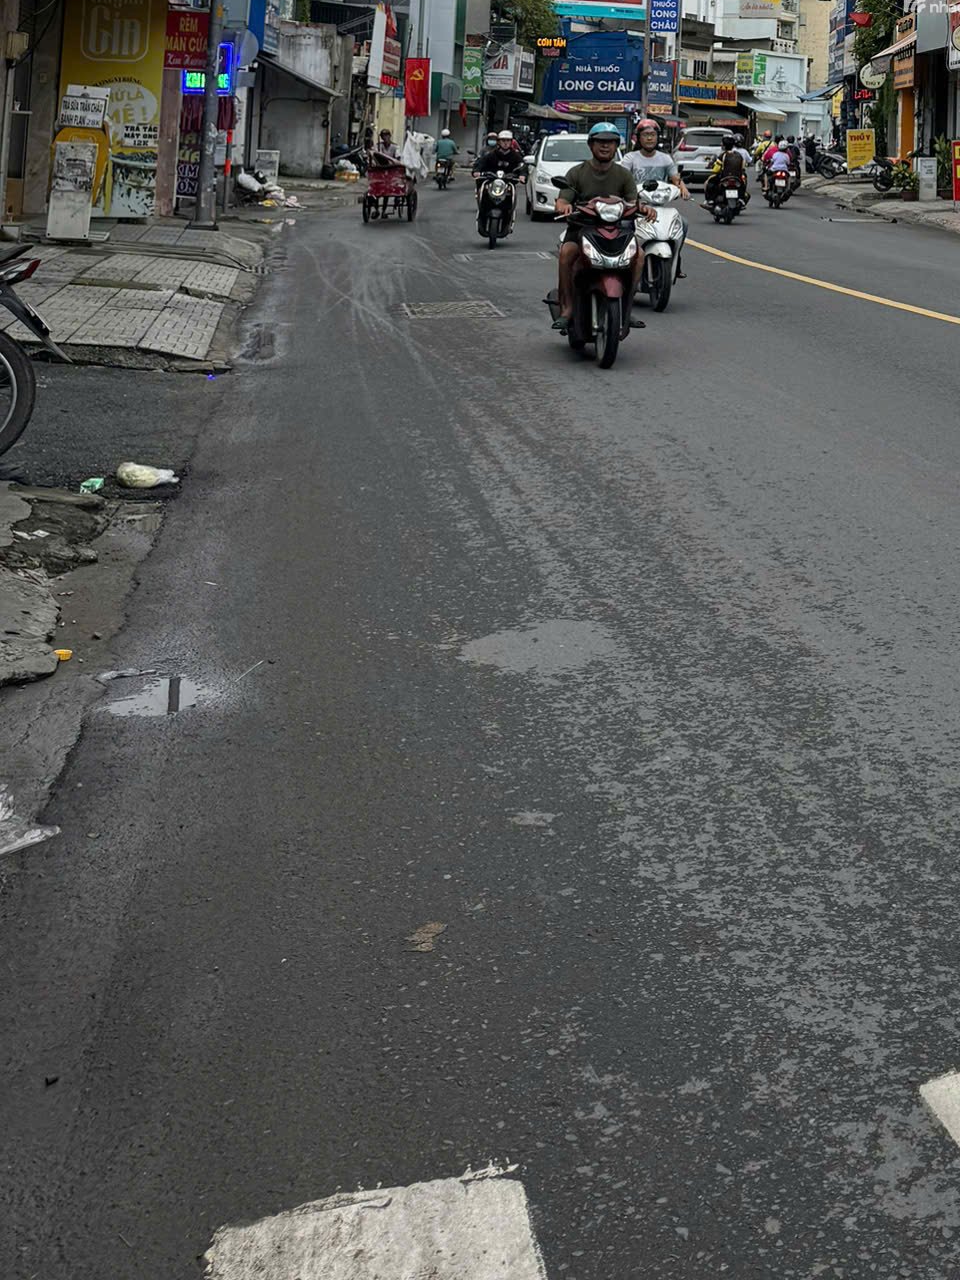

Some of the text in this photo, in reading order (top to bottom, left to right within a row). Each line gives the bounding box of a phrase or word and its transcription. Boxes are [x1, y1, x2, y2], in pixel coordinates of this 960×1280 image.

[653, 0, 677, 8] THUỐC
[651, 9, 677, 18] LONG
[650, 19, 677, 30] CHÂU
[575, 63, 620, 73] NHÀ THUỐC
[558, 78, 635, 92] LONG CHÂU
